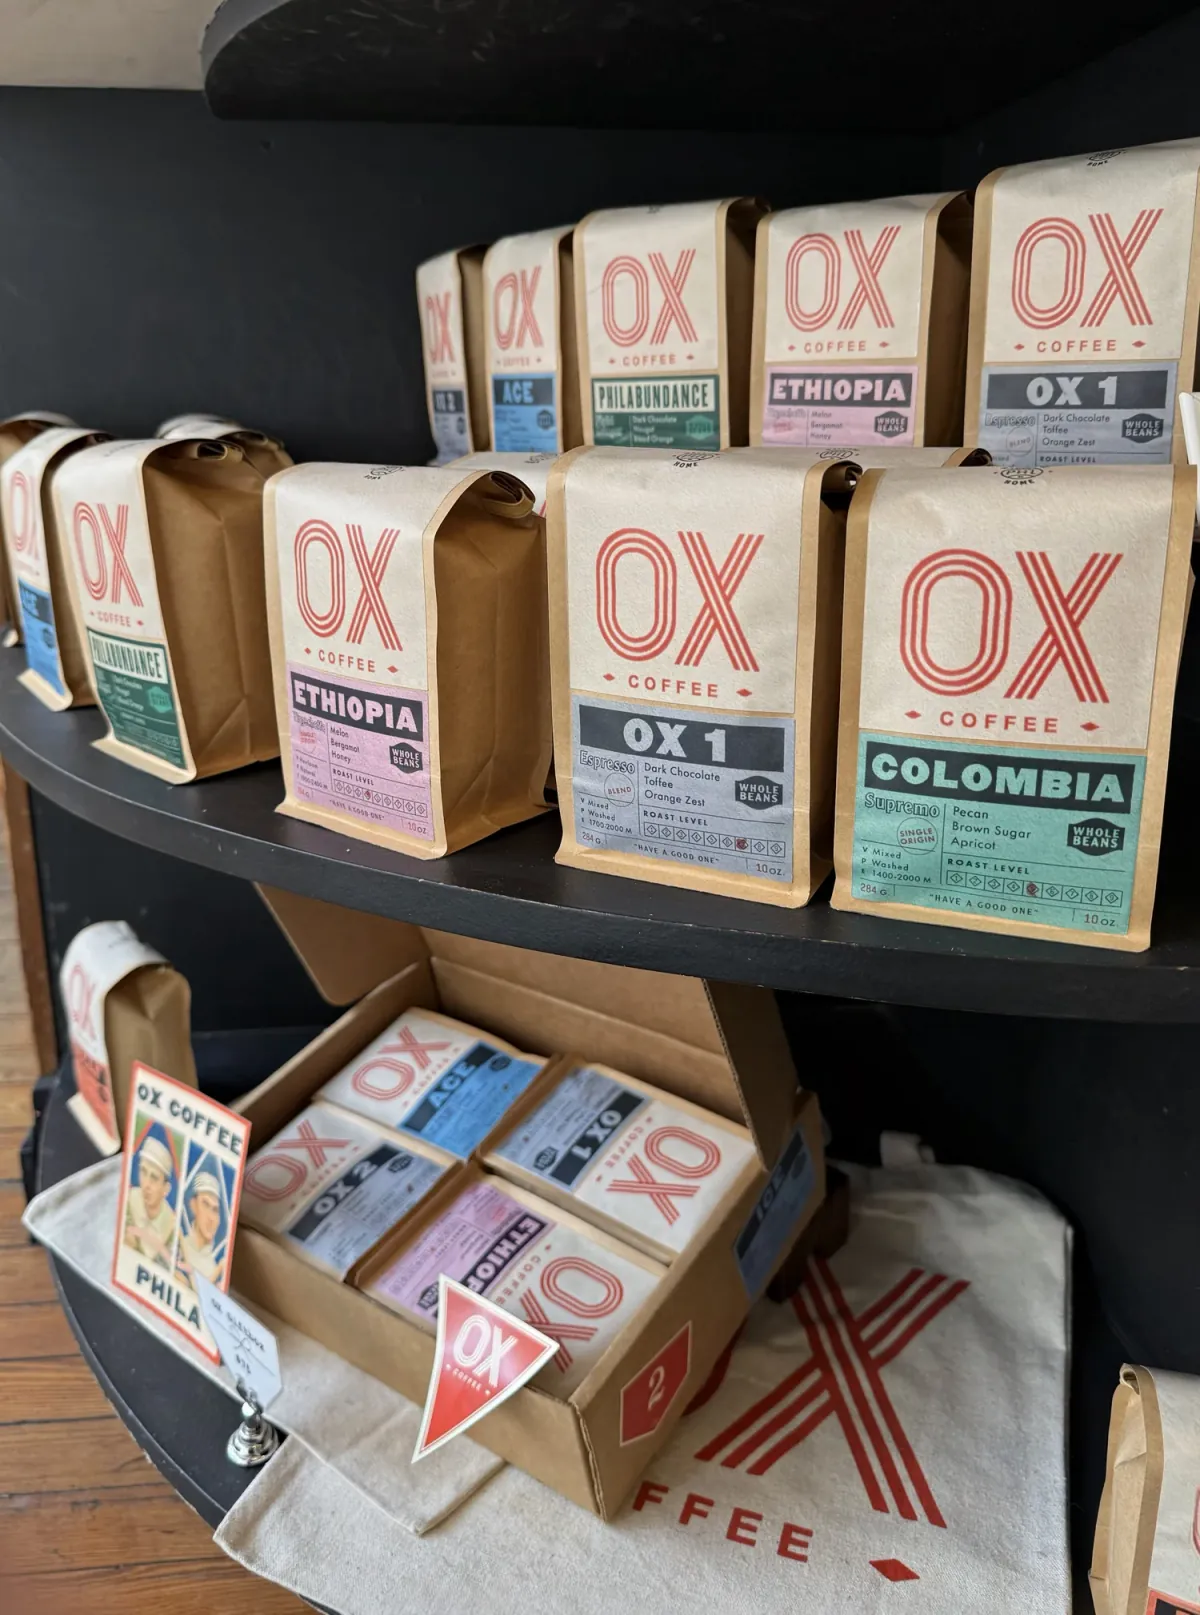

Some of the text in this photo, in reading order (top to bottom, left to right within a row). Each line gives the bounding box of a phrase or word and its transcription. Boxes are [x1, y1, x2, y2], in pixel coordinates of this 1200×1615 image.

[1011, 208, 1164, 331] OX
[785, 225, 901, 332] OX
[601, 249, 699, 347] OX
[493, 266, 543, 351] OX
[426, 291, 456, 365] OX
[804, 340, 867, 353] COFFEE
[1036, 340, 1117, 353] COFFEE
[622, 354, 677, 367] COFFEE
[503, 381, 534, 403] ACE
[599, 383, 709, 409] PHILABUNDANCE
[772, 379, 906, 402] ETHIOPIA
[1026, 376, 1118, 406] OX 1
[877, 417, 906, 425] WHOLE
[985, 412, 1036, 429] Espresso
[1043, 413, 1110, 423] Dark Chocolate
[1125, 420, 1160, 429] WHOLE
[876, 424, 905, 433] BEANS
[1043, 425, 1068, 434] Toffee
[1125, 428, 1160, 437] BEANS
[1042, 437, 1095, 447] Orange Zest
[73, 501, 144, 607] OX
[294, 519, 403, 652] OX
[595, 527, 765, 673] OX
[899, 548, 1124, 704] OX
[318, 650, 376, 673] COFFEE
[628, 674, 718, 698] COFFEE
[293, 679, 418, 733] ETHIOPIA
[940, 711, 1058, 733] COFFEE
[330, 727, 349, 738] Melon
[623, 718, 726, 763] OX 1
[331, 738, 360, 753] Bergamot
[331, 750, 352, 764] Honey
[391, 748, 420, 761] WHOLE
[393, 757, 420, 769] BEANS
[580, 750, 635, 774] Espresso
[332, 768, 374, 785] ROAST LEVEL
[644, 762, 721, 782] Dark Chocolate
[871, 753, 1125, 802] COLOMBIA
[608, 786, 632, 795] BLEND
[644, 777, 673, 789] Toffee
[739, 783, 779, 794] WHOLE
[588, 800, 609, 810] Mixed
[644, 790, 705, 807] Orange Zest
[739, 792, 778, 803] BEANS
[864, 792, 940, 818] Supremo
[587, 810, 616, 821] Washed
[643, 810, 708, 826] ROAST LEVEL
[953, 806, 989, 820] Pecan
[408, 822, 416, 831] 10
[899, 828, 933, 838] SINGLE
[952, 821, 1032, 840] Brown Sugar
[1073, 827, 1120, 839] WHOLE
[900, 836, 936, 845] ORIGIN
[950, 836, 997, 851] Apricot
[1072, 836, 1119, 848] BEANS
[671, 850, 694, 860] GOOD
[872, 849, 902, 859] Mixed
[756, 863, 767, 873] 10
[872, 859, 909, 871] Washed
[947, 858, 1030, 875] ROAST LEVEL
[872, 869, 921, 882] 1400-2000
[860, 883, 877, 894] 284
[977, 902, 1006, 912] GOOD
[1084, 913, 1098, 925] 10
[352, 1025, 452, 1101] OX
[428, 1062, 477, 1108] ACE
[137, 1083, 243, 1156] OX COFFEE
[570, 1108, 624, 1161] OX 1
[604, 1126, 644, 1169] COFFEE
[244, 1119, 350, 1201] OX
[606, 1126, 721, 1227] OX
[313, 1179, 352, 1216] OX
[357, 1161, 377, 1181] 2
[466, 1220, 543, 1296] ETHIOP
[495, 1257, 542, 1305] COFFEE
[135, 1263, 200, 1330] PHILA
[519, 1256, 624, 1375] OX
[453, 1314, 519, 1388] OX
[453, 1368, 482, 1392] COFFEE
[648, 1365, 665, 1412] 2
[682, 1258, 972, 1529] X
[632, 1480, 813, 1563] FFEE
